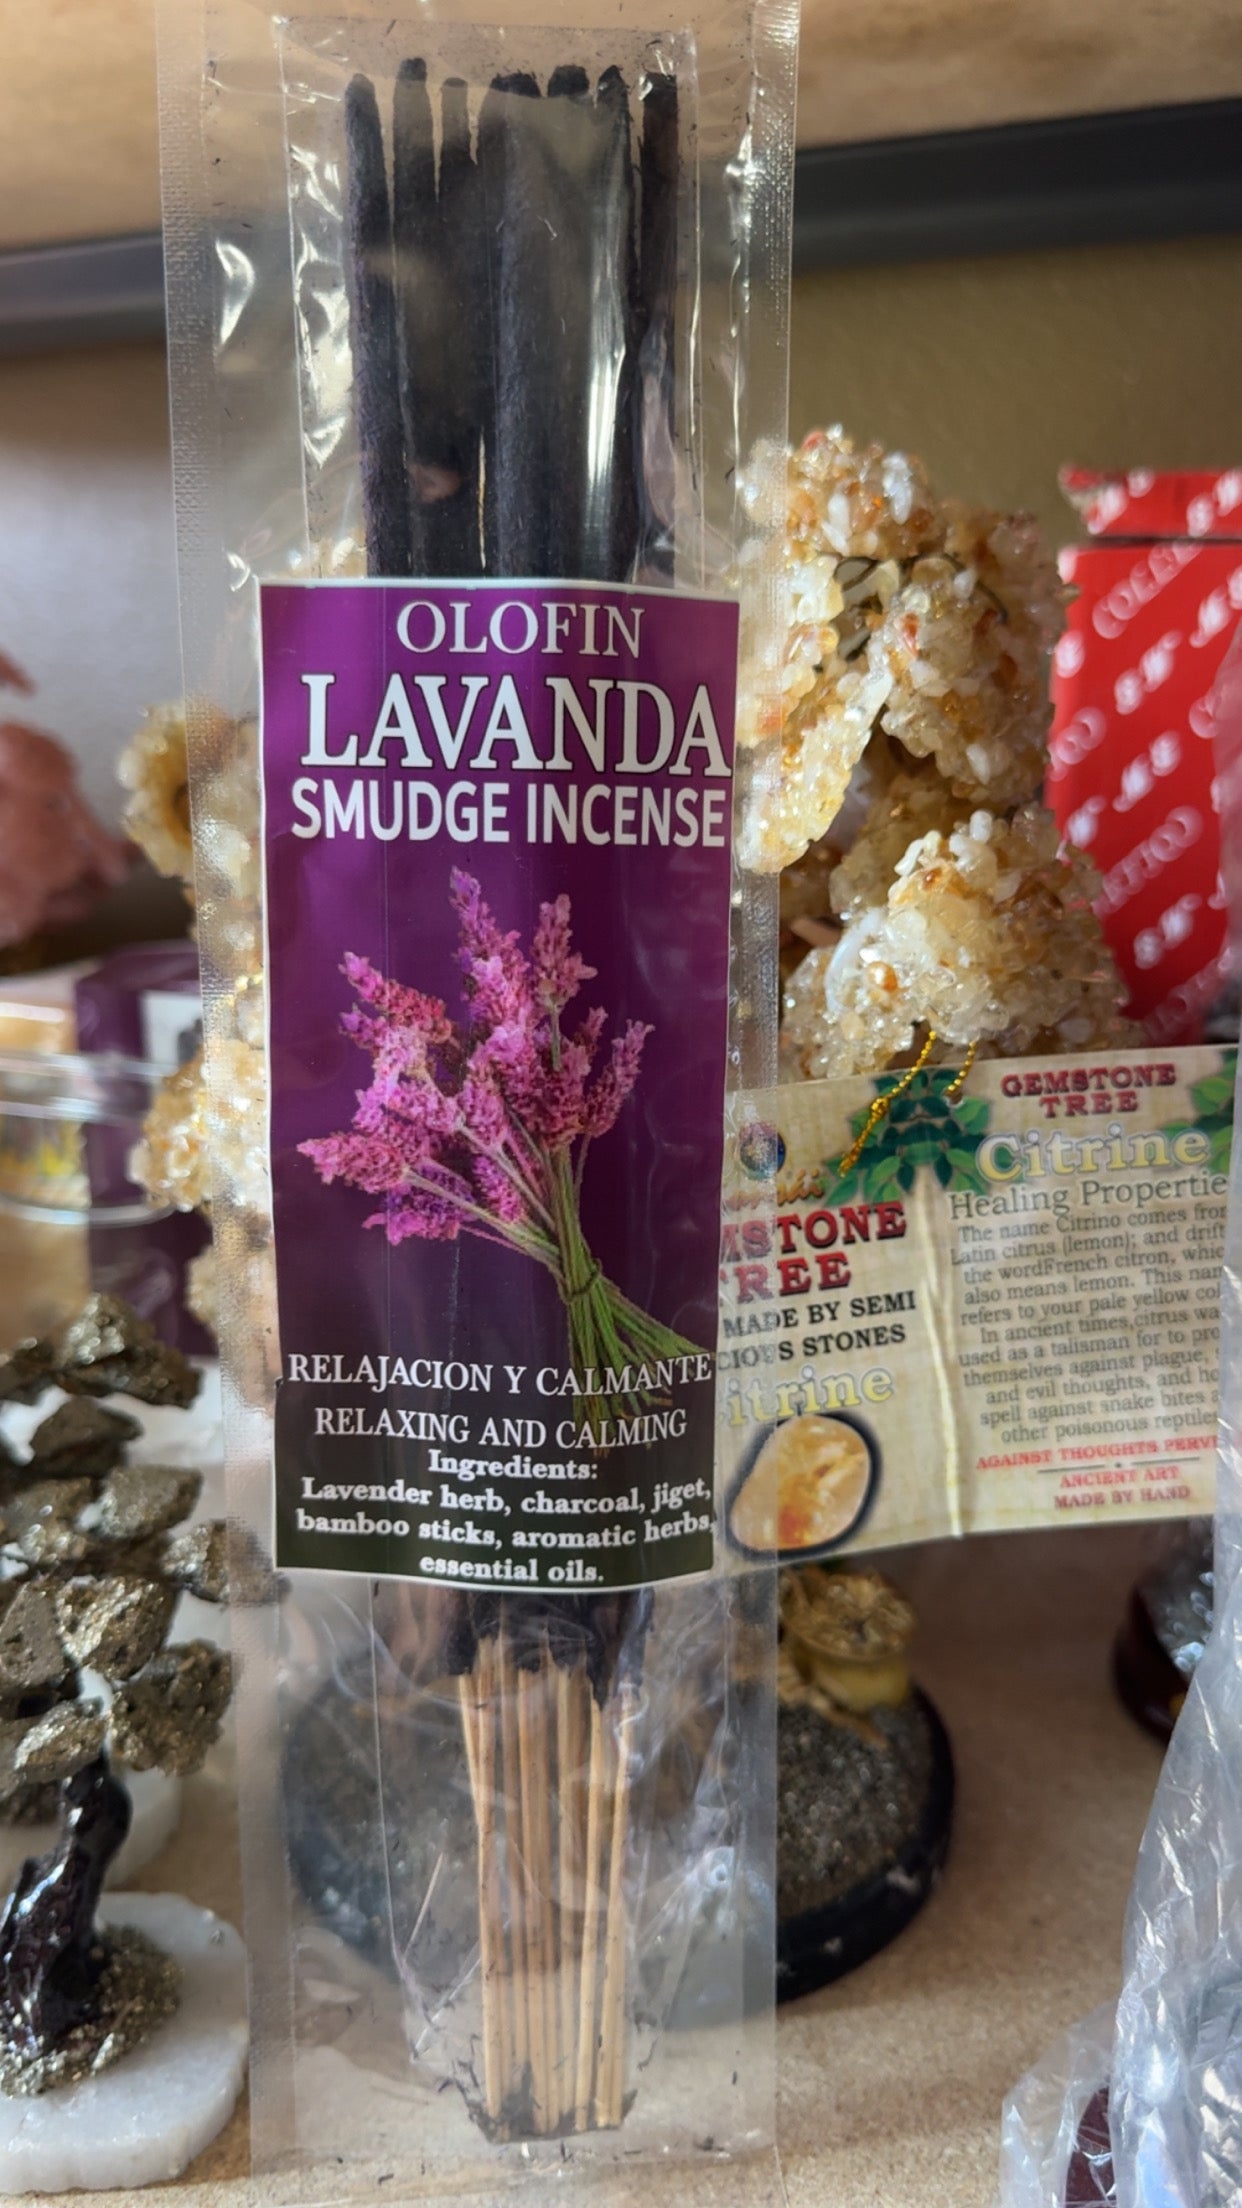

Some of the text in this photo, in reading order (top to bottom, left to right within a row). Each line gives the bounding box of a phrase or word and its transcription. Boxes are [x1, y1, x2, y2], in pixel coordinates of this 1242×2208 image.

[396, 600, 646, 659] OLOFIN
[300, 672, 733, 777] LAVANDA
[291, 776, 726, 849] SMUDGE INCENSE
[1001, 1063, 1177, 1098] GEMSTONE
[1039, 1091, 1139, 1119] TREE
[976, 1123, 1212, 1183] Citrine
[949, 1169, 1228, 1220] Healing Propertie
[958, 1224, 993, 1243] The
[999, 1221, 1050, 1240] name
[1055, 1212, 1121, 1234] Citrino
[1126, 1208, 1188, 1227] comes
[949, 1246, 996, 1266] Latin
[1001, 1241, 1057, 1260] citrus
[1142, 1226, 1179, 1246] and
[718, 1251, 853, 1306] REE
[963, 1266, 993, 1285] the
[963, 1285, 1001, 1306] also
[1006, 1280, 1069, 1301] means
[1073, 1273, 1136, 1294] lemon.
[1141, 1266, 1183, 1286] This
[723, 1289, 917, 1339] MADE BY SEMI
[960, 1305, 1013, 1327] refers
[1018, 1304, 1036, 1320] to
[1038, 1300, 1084, 1323] your
[1088, 1292, 1127, 1318] pale
[1132, 1286, 1190, 1312] yellow
[802, 1323, 907, 1357] STONES
[958, 1345, 1001, 1367] used
[1007, 1347, 1029, 1362] as
[1033, 1345, 1045, 1359] a
[1050, 1336, 1131, 1358] talisman
[1136, 1328, 1162, 1348] for
[1166, 1329, 1186, 1346] to
[980, 1327, 999, 1344] In
[1004, 1319, 1075, 1342] ancient
[287, 1353, 712, 1397] RELAJACION Y CALMANTE
[962, 1361, 1064, 1388] themselves
[1068, 1355, 1136, 1379] against
[1142, 1349, 1210, 1373] plague,
[985, 1382, 1020, 1405] and
[1025, 1379, 1057, 1401] evil
[1062, 1373, 1152, 1397] thoughts,
[1156, 1365, 1193, 1387] and
[714, 1364, 895, 1427] itrine
[979, 1404, 1021, 1429] spell
[1026, 1399, 1094, 1424] against
[1099, 1391, 1156, 1413] snake
[1159, 1388, 1206, 1408] bites
[314, 1406, 688, 1449] RELAXING AND CALMING
[1000, 1423, 1049, 1445] other
[1054, 1417, 1150, 1443] poisonous
[427, 1448, 599, 1482] Ingredients:
[976, 1448, 1052, 1471] AGAINST
[1058, 1439, 1160, 1462] THOUGHTS
[300, 1476, 712, 1517] Lavender herb, charcoal, jiget,
[1060, 1464, 1181, 1489] ANCIENT ART
[1053, 1484, 1192, 1511] MADE BY HAND
[296, 1508, 717, 1549] bamboo sticks, aromatic herbs,
[419, 1552, 604, 1583] essential oils.
